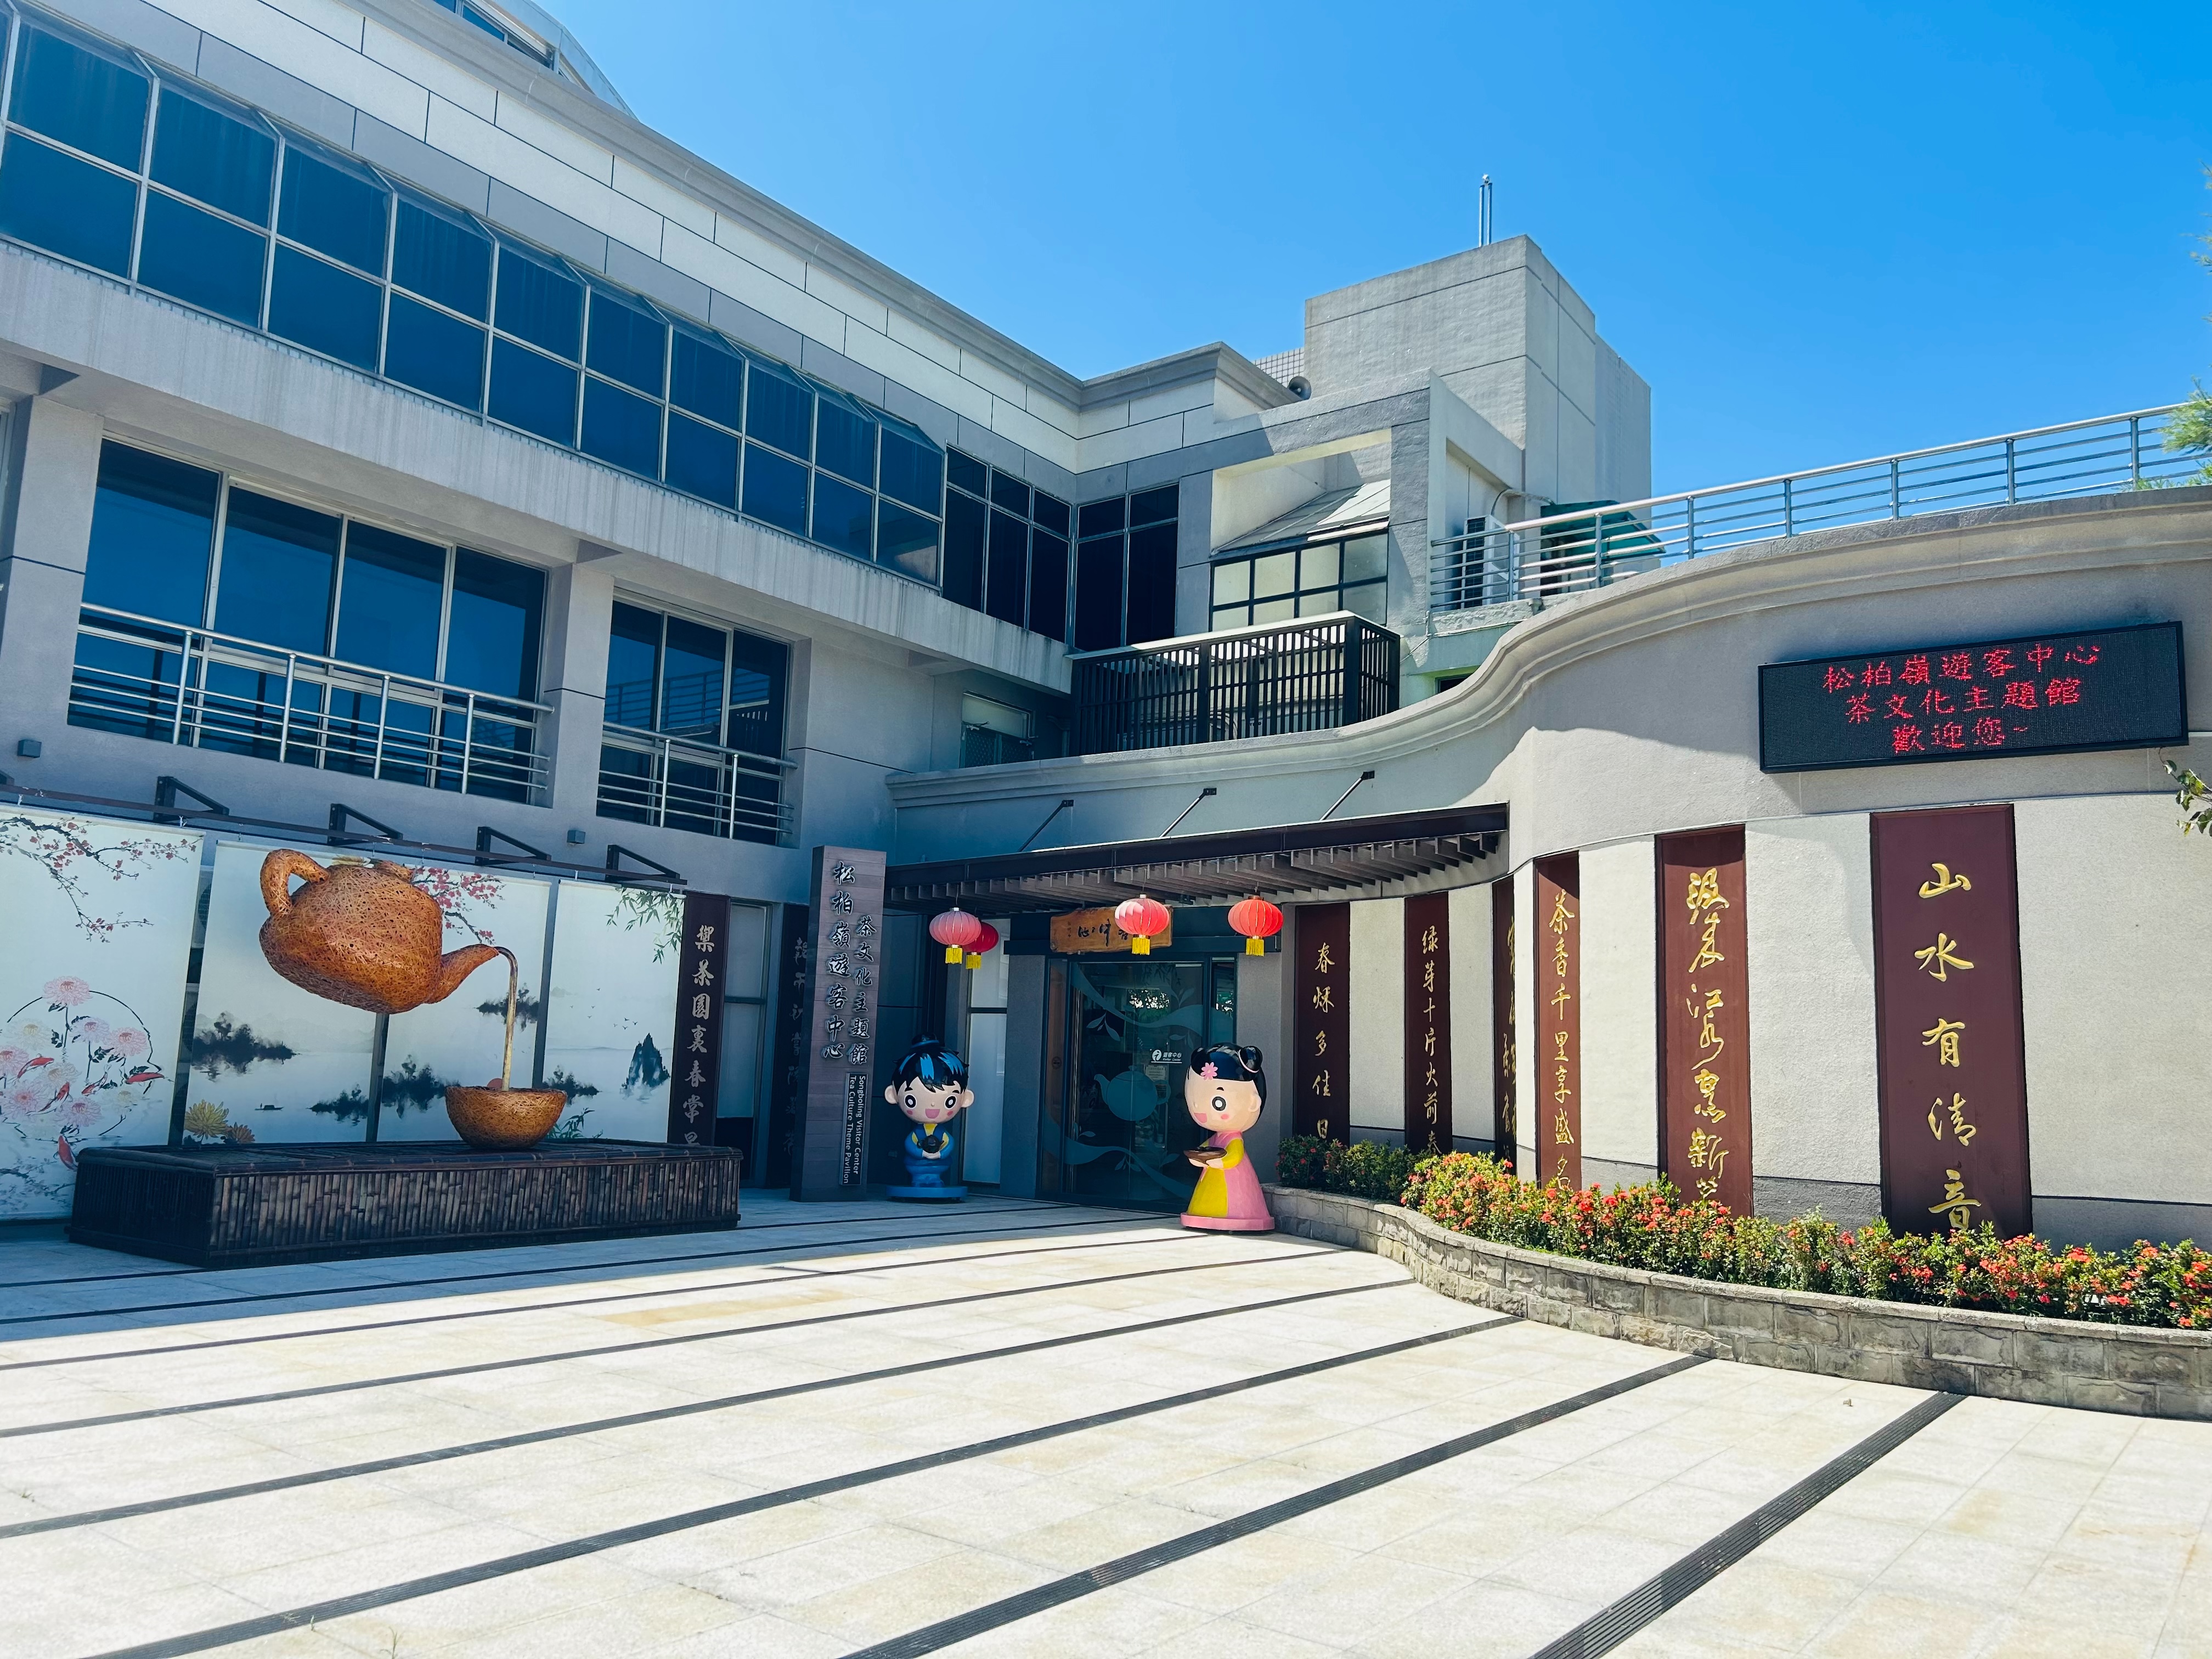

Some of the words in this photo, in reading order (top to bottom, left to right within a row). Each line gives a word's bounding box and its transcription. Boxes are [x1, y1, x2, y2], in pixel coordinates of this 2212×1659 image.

[1822, 644, 2101, 692] 松柏嶺遊客中心
[1845, 678, 2083, 724] 茶文化主題館
[822, 861, 855, 1060] 松柏嶺遊客中心
[848, 915, 877, 1065] 茶文化主題館
[1548, 889, 1575, 1190] 茶香千里享盛名
[1914, 863, 1981, 1230] 山水有清音
[856, 1076, 865, 1118] Songboling
[843, 1153, 851, 1183] Pavilion
